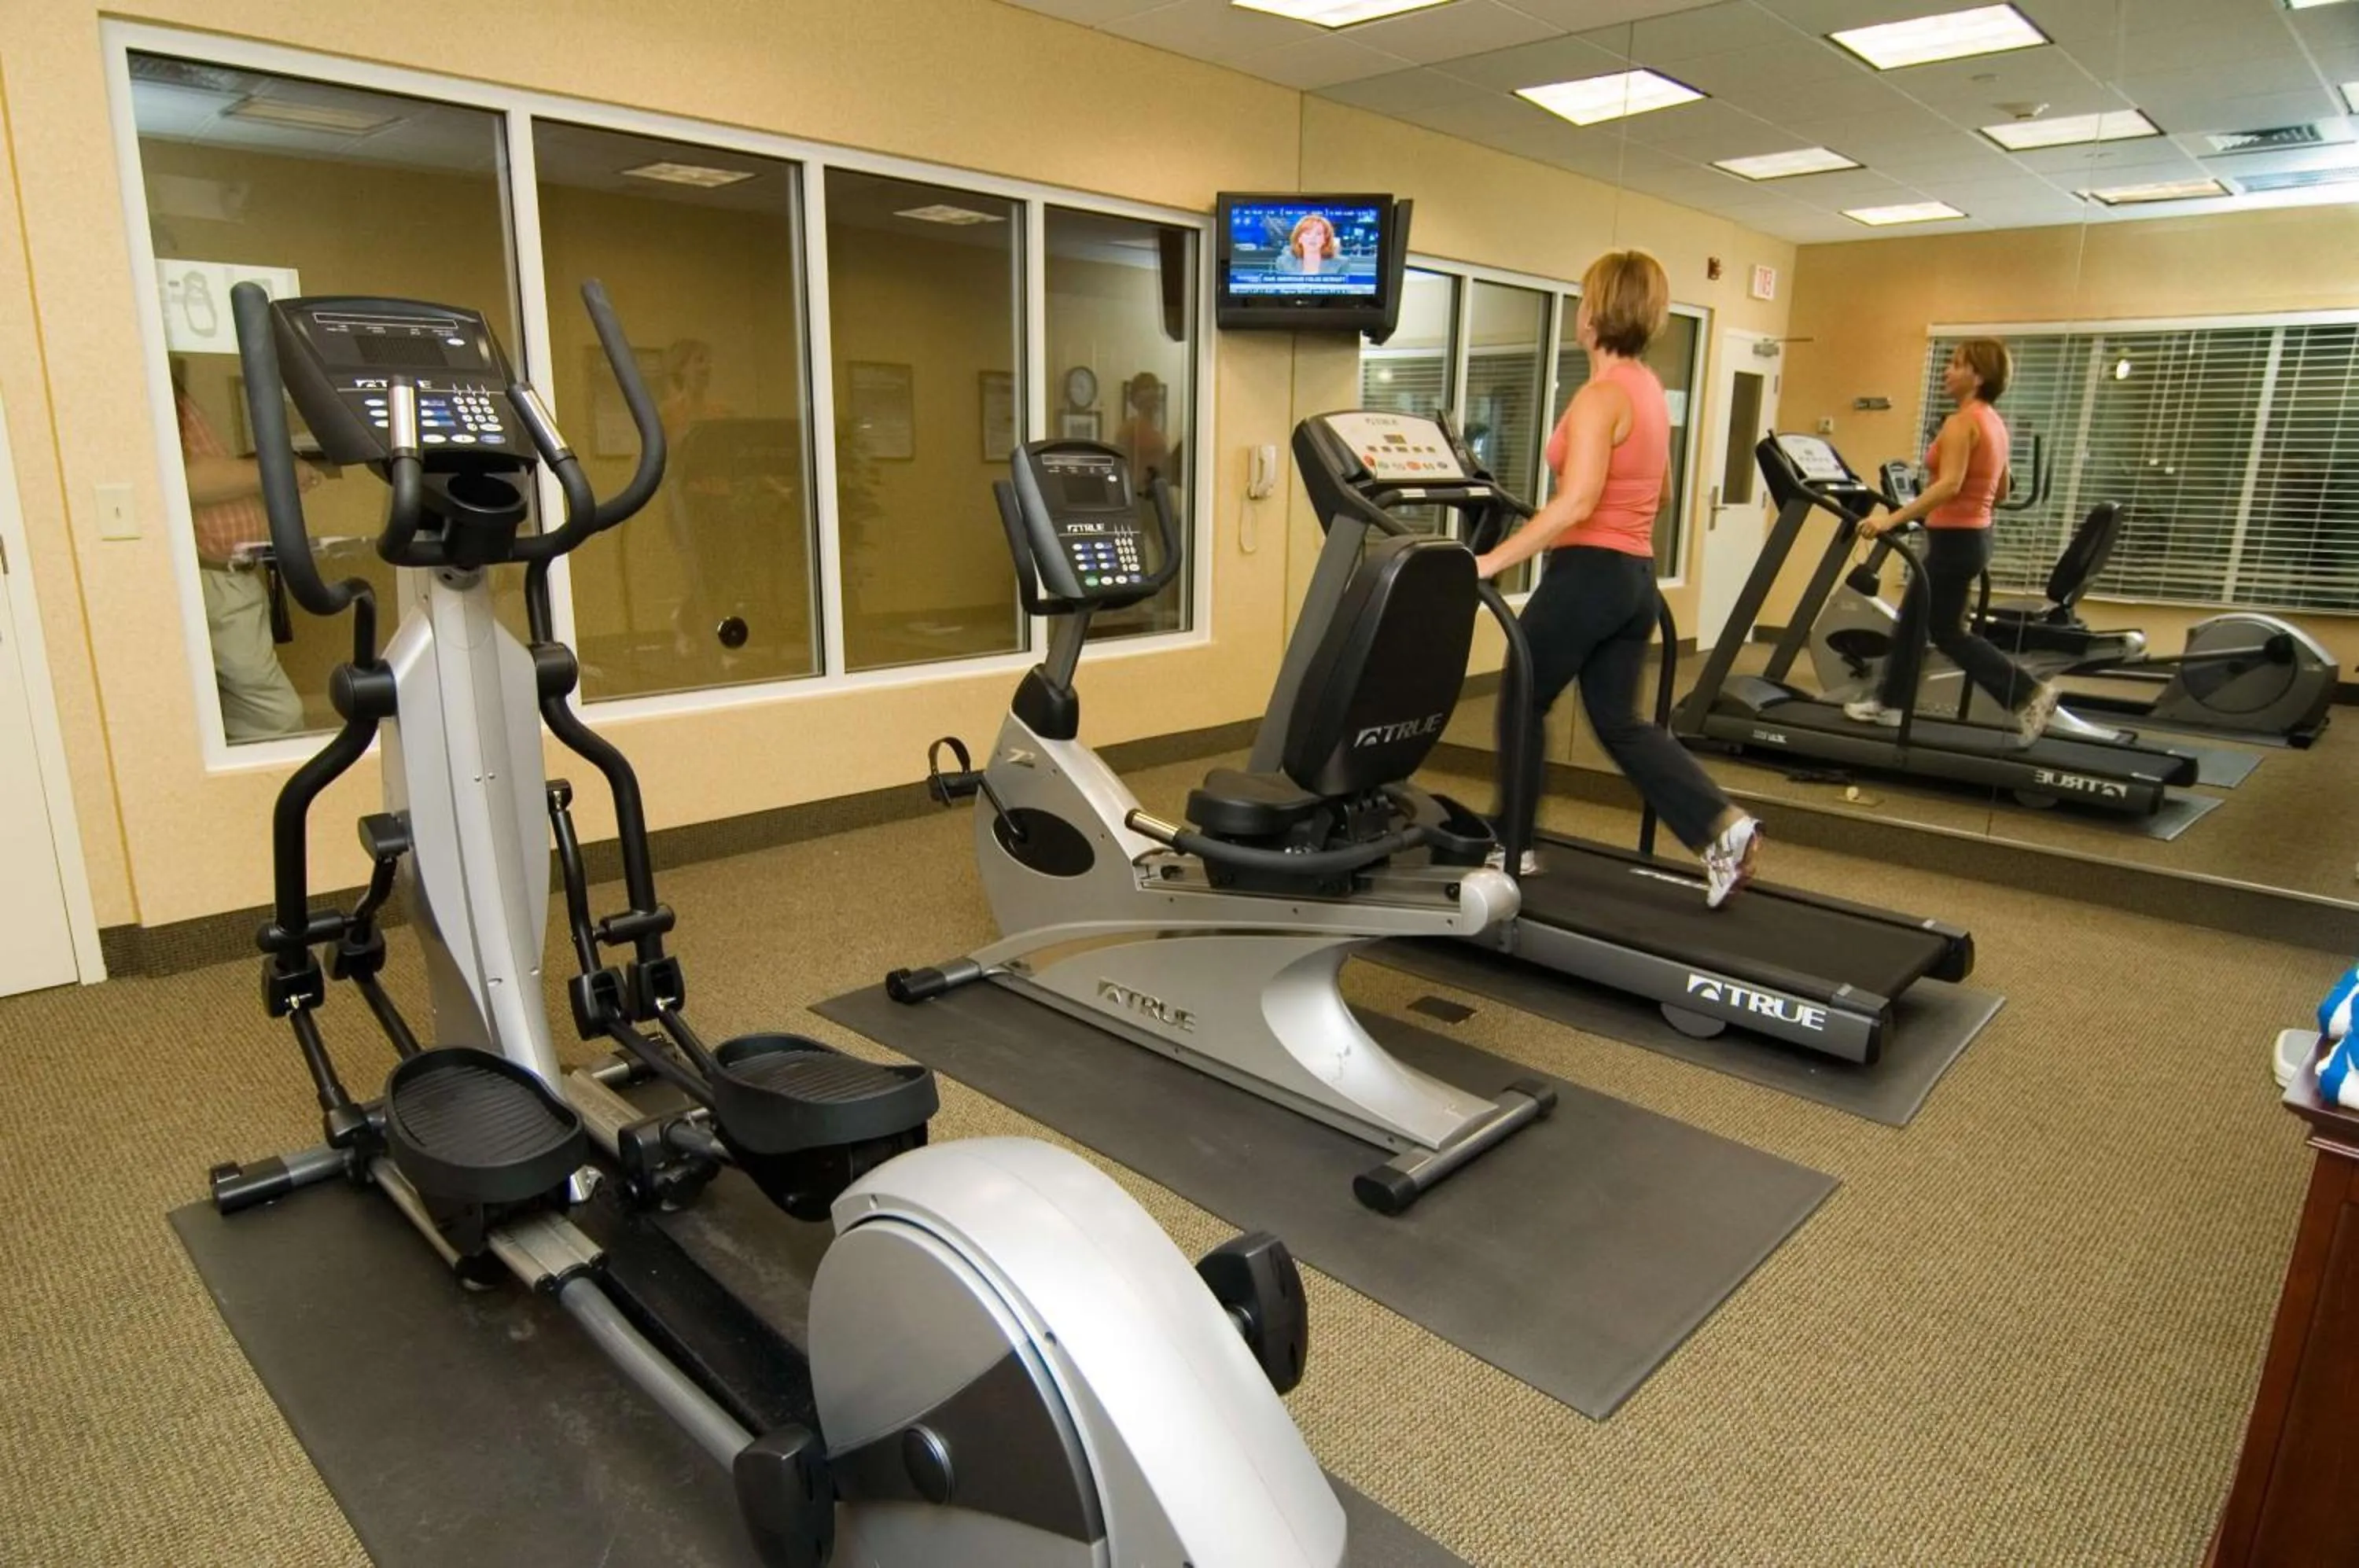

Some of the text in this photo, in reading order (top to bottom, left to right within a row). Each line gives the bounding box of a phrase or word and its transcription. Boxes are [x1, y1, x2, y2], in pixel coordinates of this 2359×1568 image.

[1384, 712, 1444, 742] TRUE
[1120, 986, 1196, 1033] TRUE
[1724, 984, 1827, 1031] TRUE
